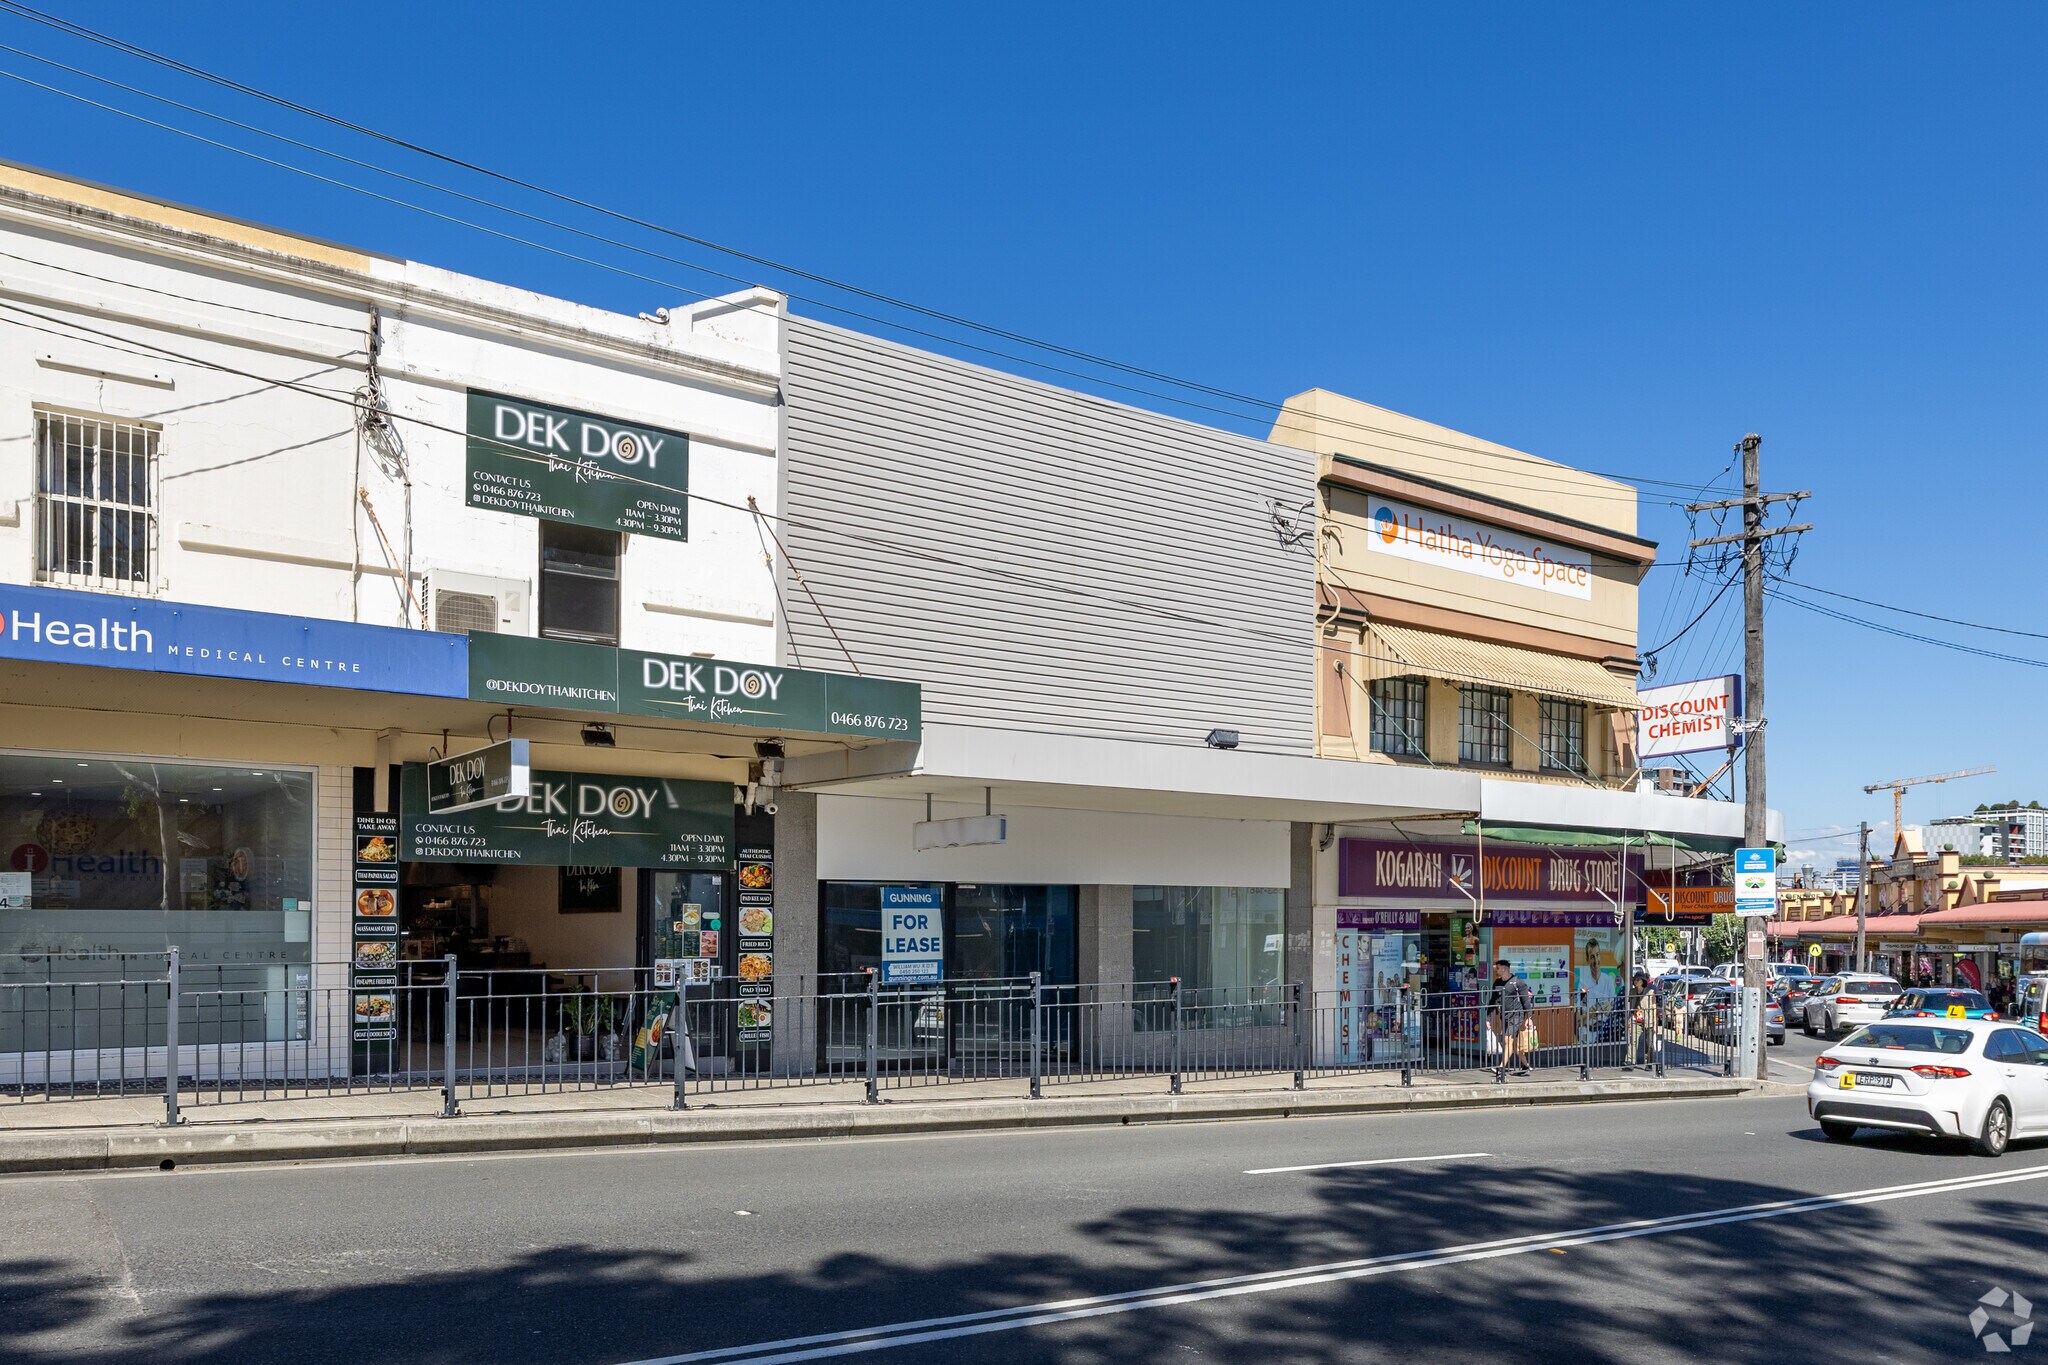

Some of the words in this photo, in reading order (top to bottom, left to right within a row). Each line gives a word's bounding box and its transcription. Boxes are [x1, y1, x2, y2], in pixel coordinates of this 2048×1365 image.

[494, 405, 570, 452] DEK
[580, 422, 664, 469] DOY
[549, 452, 572, 473] Thai
[575, 457, 617, 484] Kitchen
[473, 470, 517, 487] CONTACT
[519, 479, 531, 488] US
[482, 483, 505, 496] 0466
[507, 487, 524, 499] 876
[525, 490, 541, 502] 723
[482, 495, 575, 518] DEKDOYTHAIKITCHEN
[636, 499, 659, 512] OPEN
[660, 503, 682, 516] DAILY
[625, 507, 644, 519] 11AM
[654, 513, 682, 526] 3.30PM
[616, 517, 644, 530] 4.30PM
[653, 524, 682, 536] 9.30PM
[1403, 513, 1473, 560] Hatha
[1476, 530, 1527, 578] Yoga
[1532, 546, 1587, 587] Space
[11, 610, 153, 653] Health
[168, 645, 266, 664] MEDICAL
[282, 656, 361, 673] CENTRE
[643, 658, 706, 694] DEK
[714, 667, 784, 701] DOY
[485, 678, 616, 702] @DEKDOYTHAIKITCHEN
[682, 695, 707, 712] Thai
[709, 696, 744, 719] Kitchen
[1641, 694, 1729, 722] DISCOUNT
[830, 711, 861, 728] 0466
[863, 713, 886, 730] 876
[888, 715, 909, 732] 723
[1648, 716, 1724, 739] CHEMIST
[449, 762, 465, 786] DEK
[467, 756, 487, 781] DOY
[579, 784, 658, 819] DOY
[415, 823, 461, 835] CONTACT
[463, 825, 476, 835] US
[541, 818, 569, 838] Thai
[571, 817, 612, 844] Kitchen
[681, 833, 703, 843] OPEN
[703, 834, 725, 844] DAILY
[425, 836, 449, 846] 0466
[451, 836, 468, 847] 876
[469, 837, 486, 847] 723
[669, 843, 689, 853] 11AM
[698, 844, 725, 854] 3.30PM
[424, 847, 521, 859] DEKDOYTHAIKITCHEN
[660, 853, 689, 863] 4.30PM
[697, 854, 725, 864] 9.30PM
[1375, 849, 1442, 889] KOGARAH
[1483, 855, 1542, 892] DISCOUNT
[1549, 858, 1581, 892] DRUG
[1584, 860, 1618, 893] STORE
[889, 893, 932, 903] GUNNING
[1674, 891, 1711, 904] DISCOUNT
[1713, 891, 1734, 903] DRUG
[892, 914, 928, 930] FOR
[1374, 911, 1398, 924] O'REILLY
[1398, 912, 1405, 924] &
[1405, 912, 1418, 924] DALY
[885, 937, 940, 953] LEASE
[1341, 935, 1350, 1056] CHEMIST
[1950, 1007, 1958, 1017] L
[1843, 1076, 1852, 1086] L
